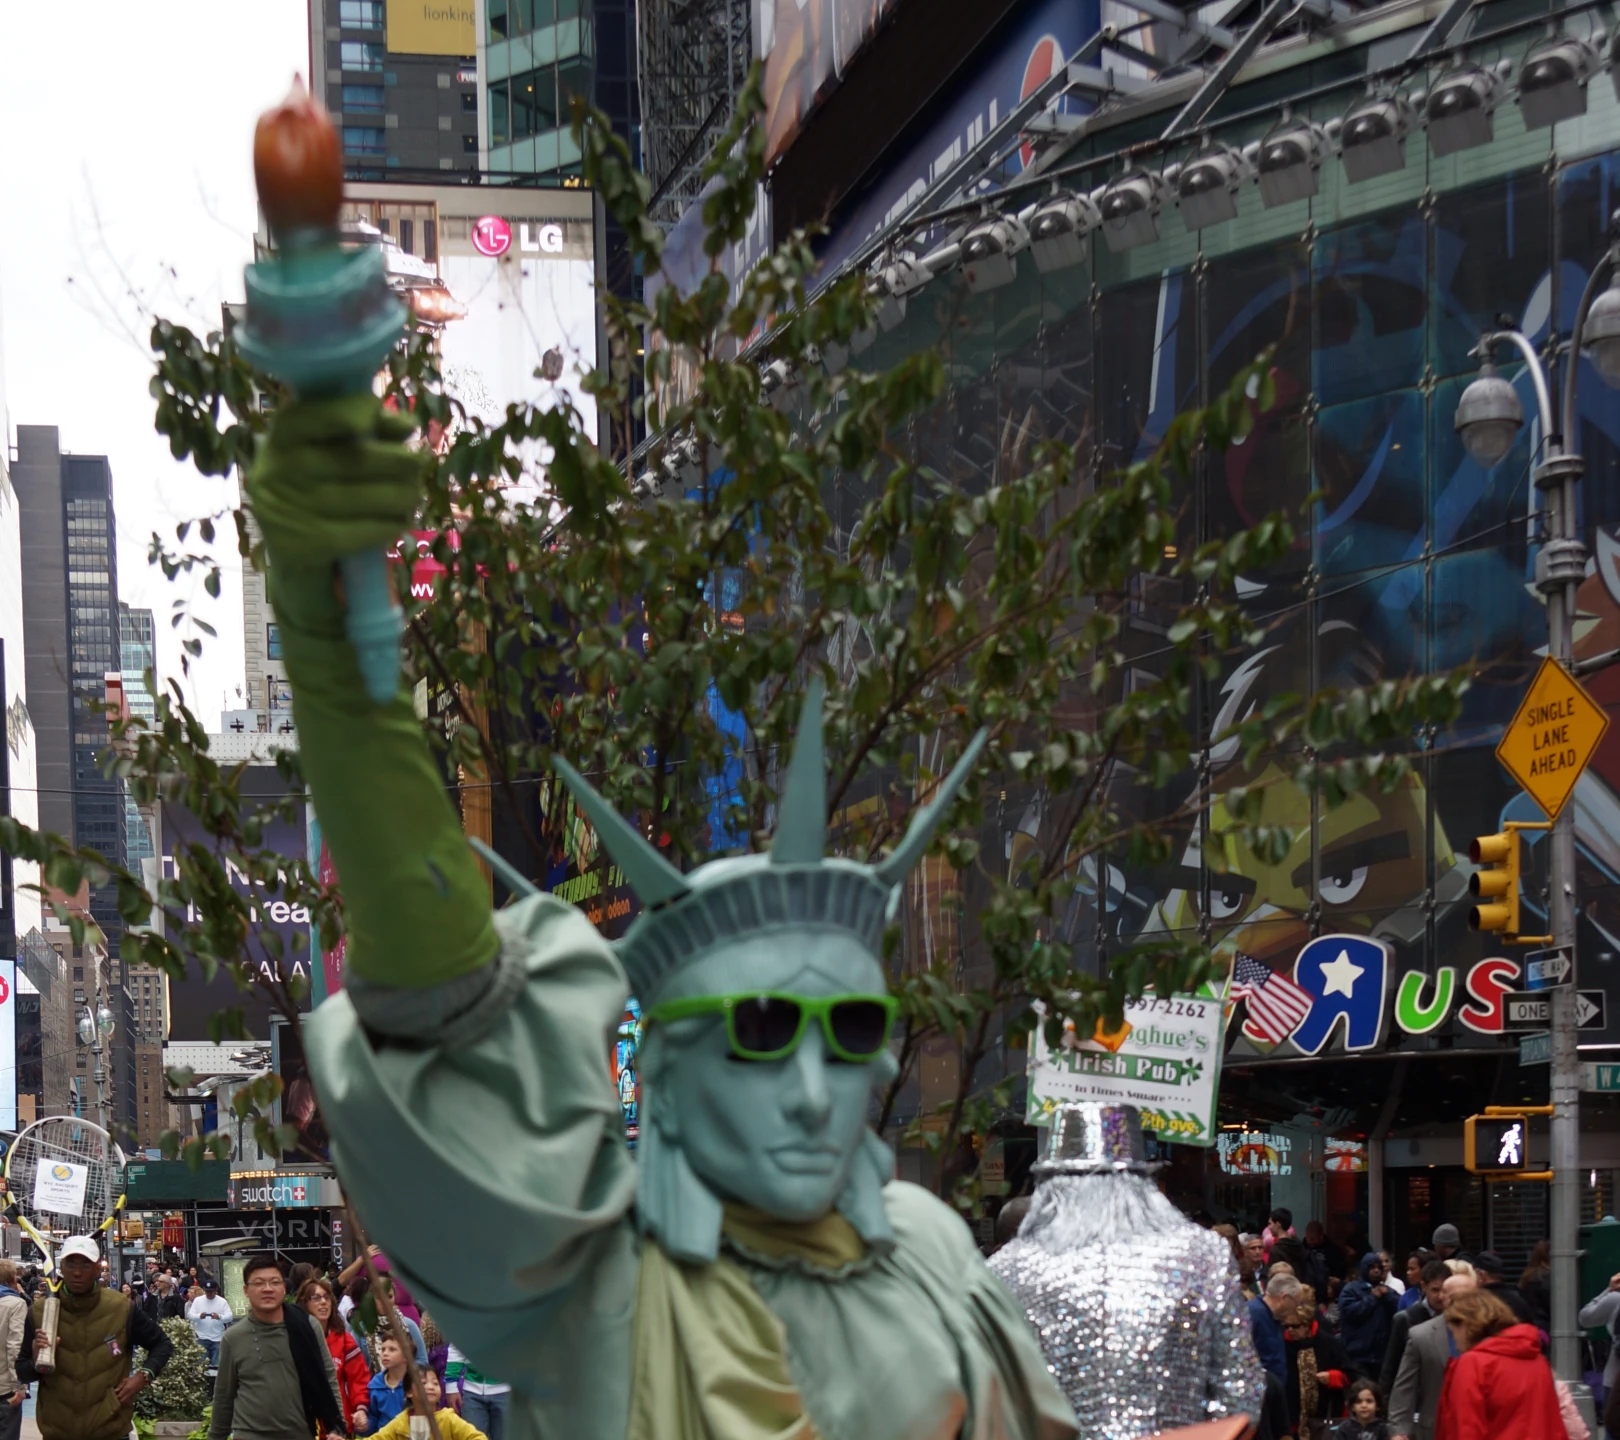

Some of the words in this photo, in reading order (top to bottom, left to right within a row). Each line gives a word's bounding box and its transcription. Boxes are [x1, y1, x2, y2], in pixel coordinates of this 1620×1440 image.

[520, 224, 563, 253] LG
[1527, 697, 1576, 727] SINGLE
[1533, 724, 1570, 751] LANE
[1529, 749, 1577, 777] AHEAD
[1518, 1004, 1547, 1019] ONE
[1576, 1003, 1590, 1018] AY
[1074, 1051, 1127, 1075] Irish
[1136, 1058, 1178, 1082] Pub
[1600, 1066, 1612, 1088] W
[1091, 1086, 1124, 1097] Times
[1127, 1089, 1166, 1102] Square
[1140, 1110, 1166, 1131] 7th
[242, 1183, 293, 1203] swatch
